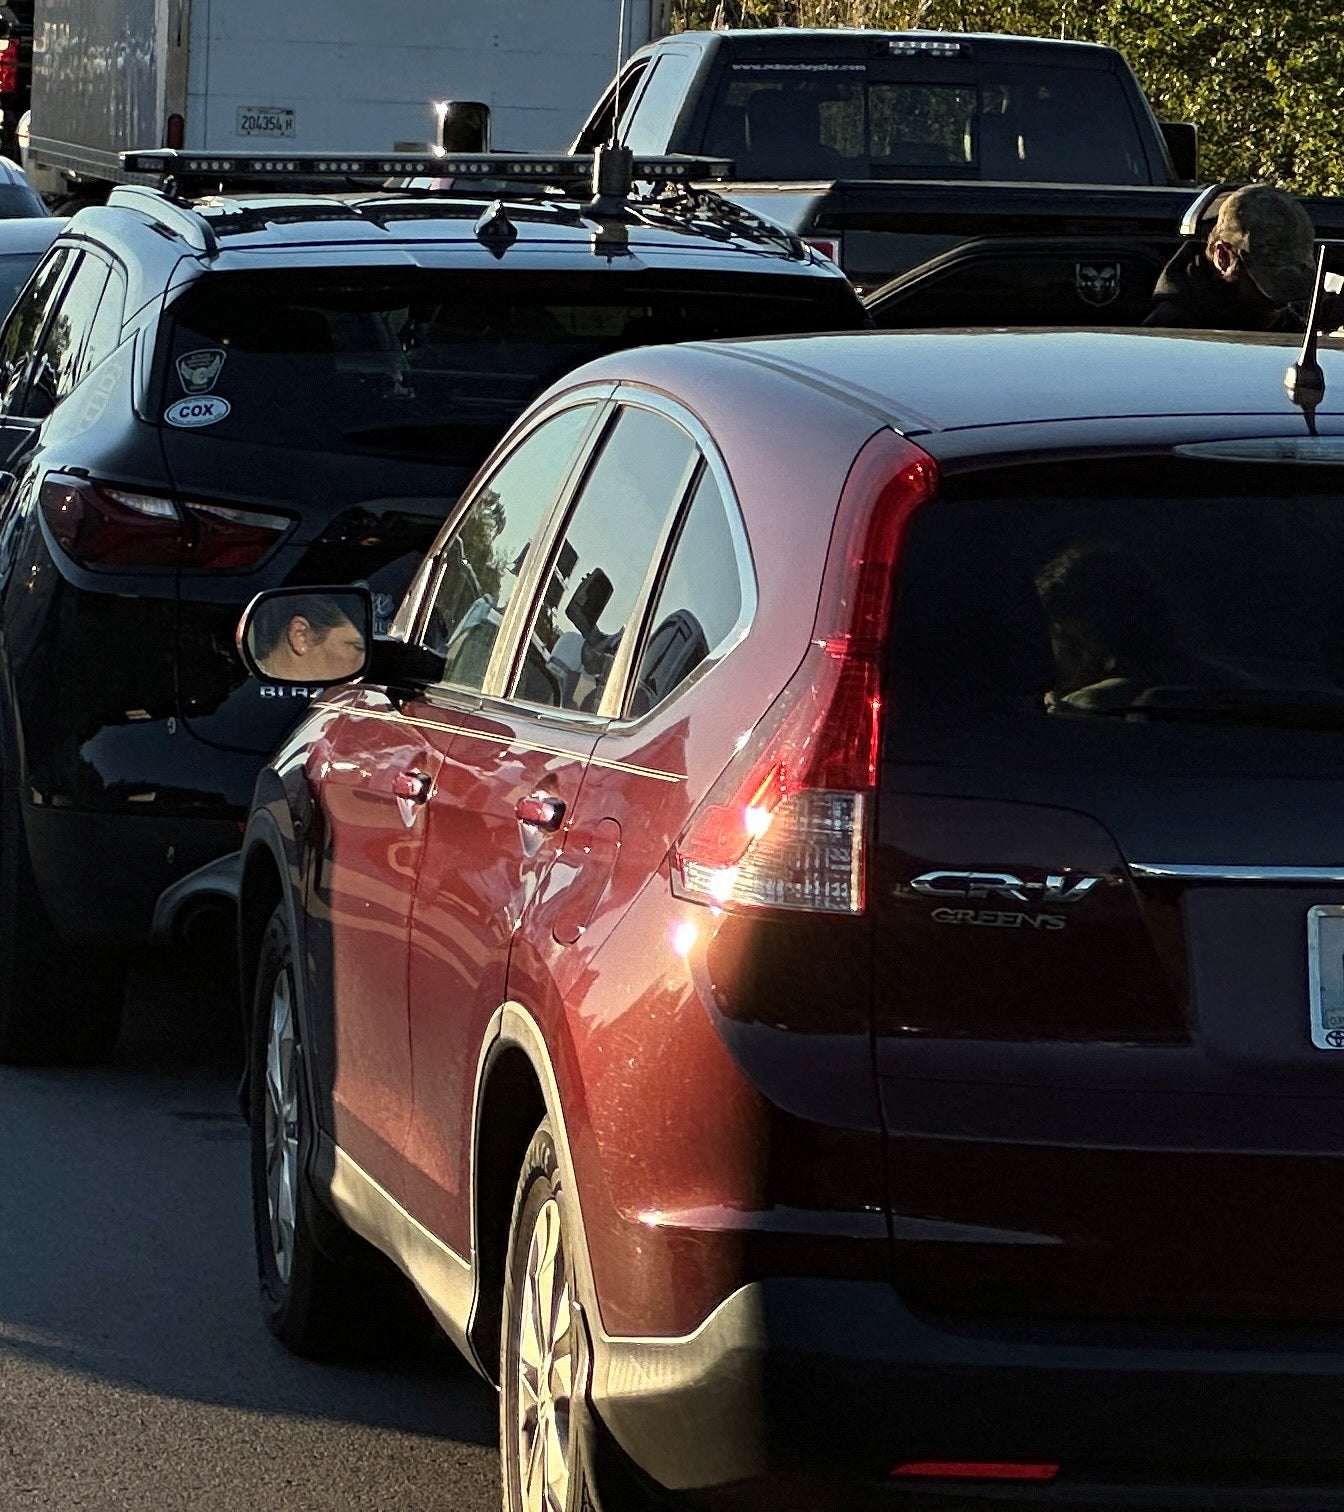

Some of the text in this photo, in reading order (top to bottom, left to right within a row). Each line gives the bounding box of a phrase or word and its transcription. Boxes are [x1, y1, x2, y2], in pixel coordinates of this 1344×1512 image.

[241, 115, 282, 131] 204354
[179, 403, 214, 418] COX
[910, 870, 1103, 904] CR-V
